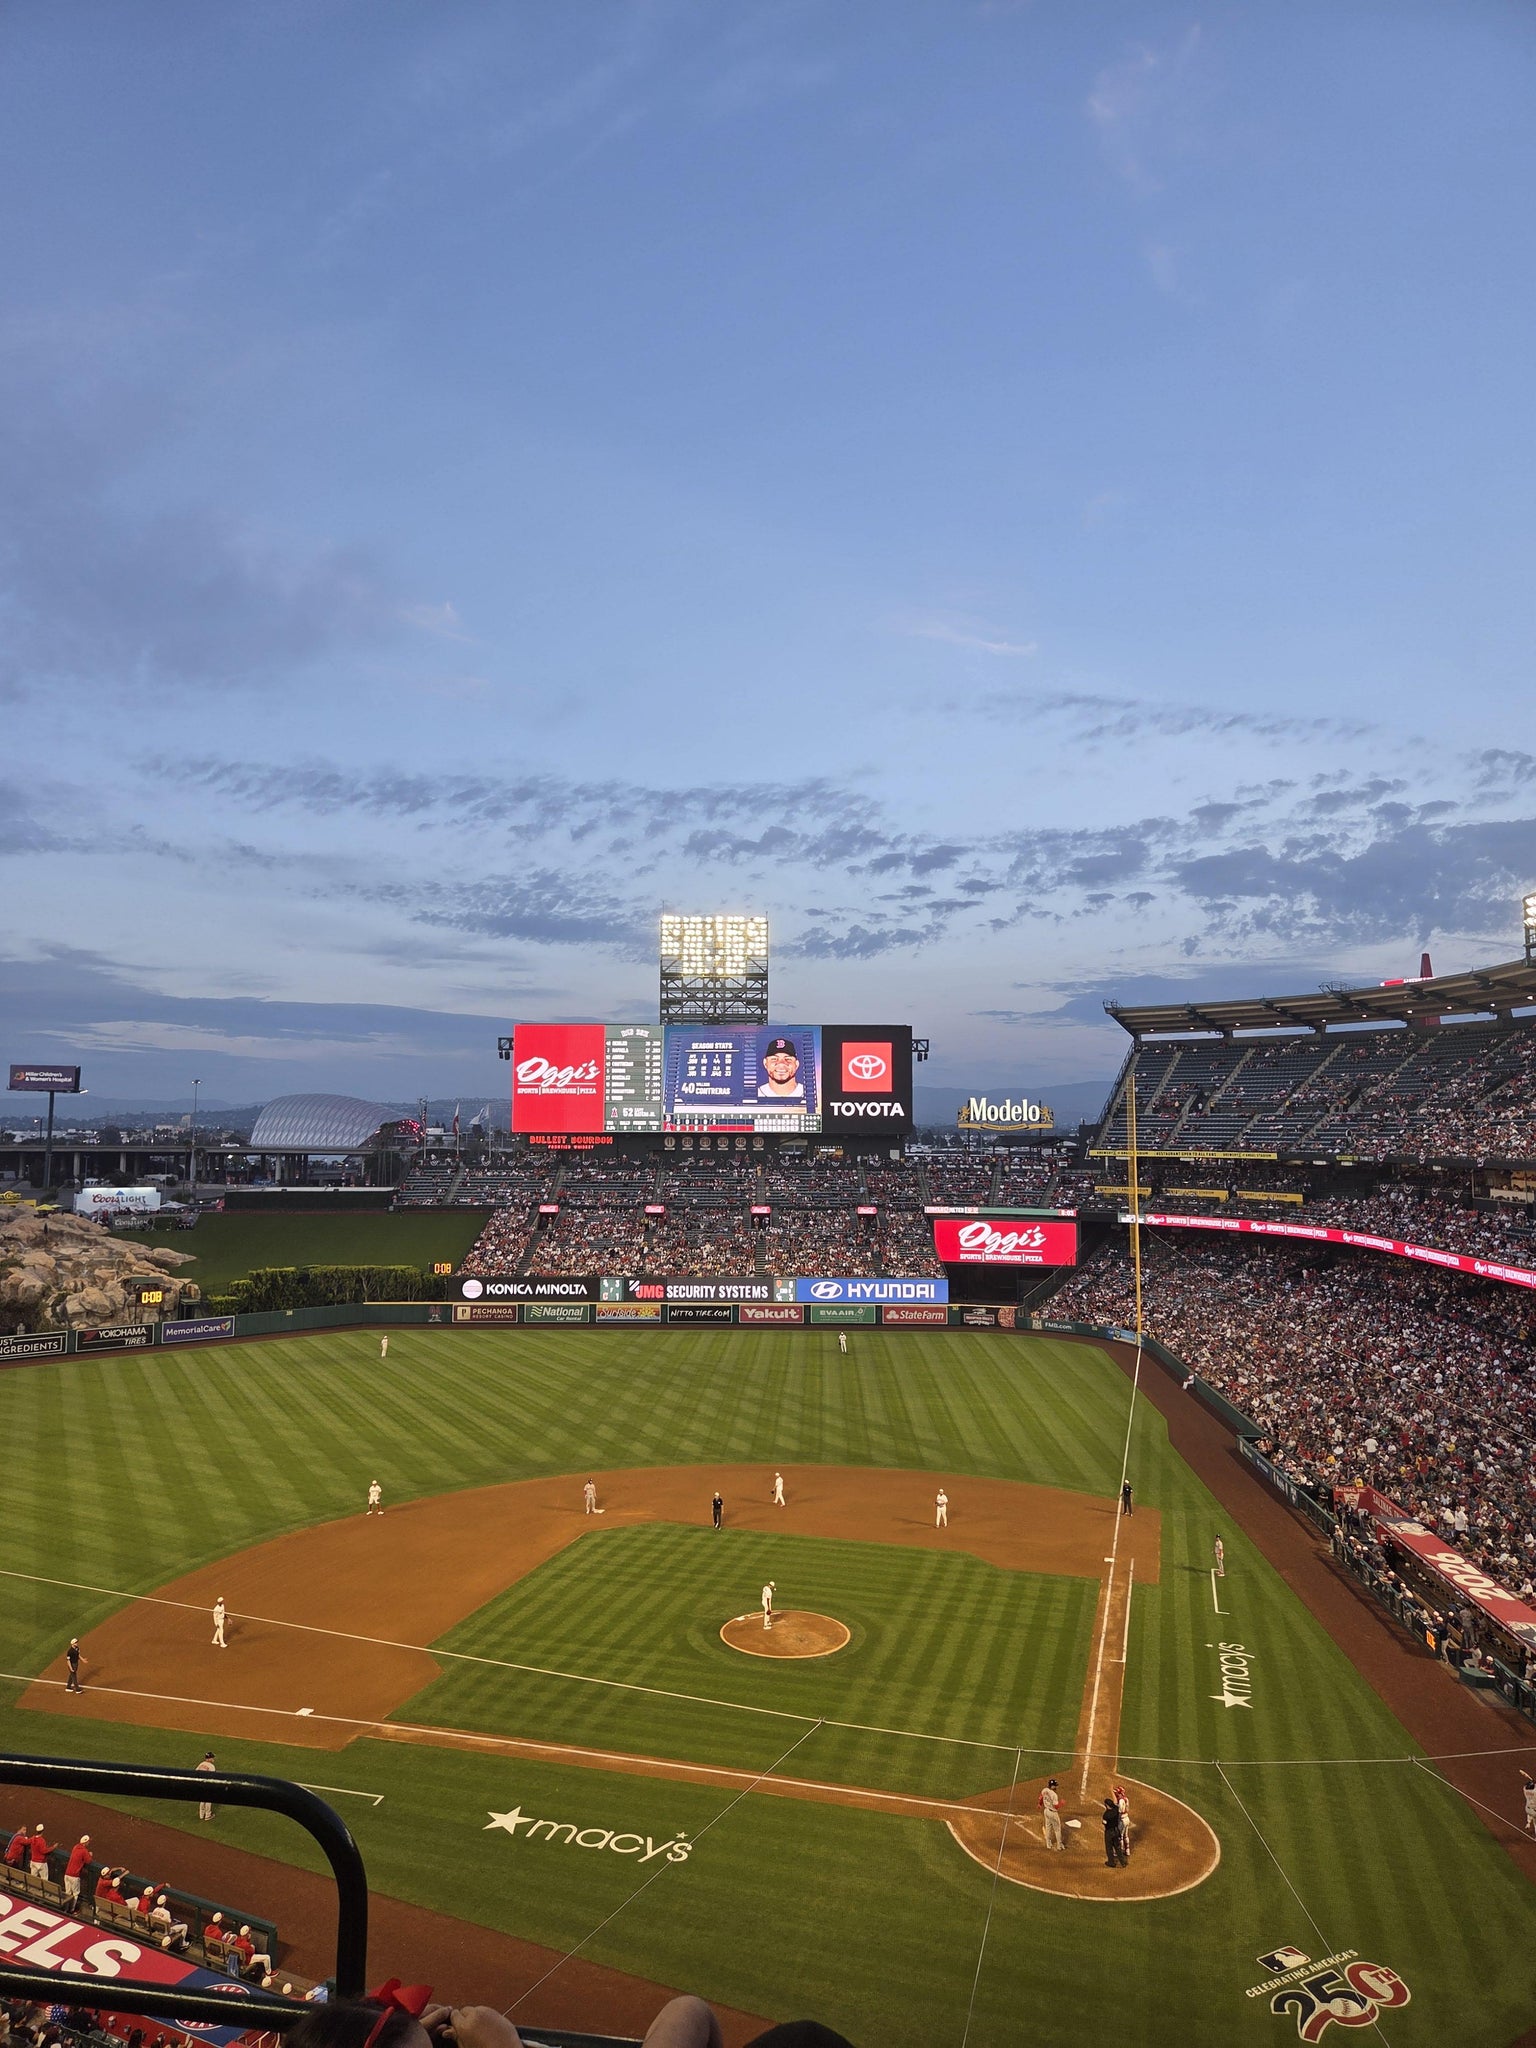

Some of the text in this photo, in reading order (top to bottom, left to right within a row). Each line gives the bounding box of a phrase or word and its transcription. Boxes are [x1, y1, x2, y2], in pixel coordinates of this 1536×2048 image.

[516, 1056, 600, 1088] Oggi's
[682, 1082, 696, 1094] 40
[830, 1102, 905, 1116] TOYOTA
[970, 1097, 1040, 1122] Modelo
[530, 1136, 613, 1144] BULLEIT BOURBON
[92, 1194, 120, 1202] Coors
[958, 1222, 1046, 1254] Oggi's
[434, 1263, 452, 1274] 0:08
[486, 1284, 588, 1295] KONICA MINOLTA
[636, 1285, 768, 1299] JMG SECURITY SYSTEMS
[848, 1284, 934, 1298] HYUNDAI
[142, 1291, 162, 1304] 0:08
[542, 1307, 583, 1317] National
[600, 1307, 636, 1320] Surfside
[671, 1309, 730, 1318] NITTO TIRE.COM
[744, 1308, 798, 1319] Yakult
[98, 1327, 147, 1338] YOKOHAMA
[166, 1324, 221, 1336] MemorialCare
[124, 1337, 146, 1346] TIRES
[1424, 1552, 1516, 1600] 2026
[1245, 1949, 1359, 1998] CELEBRATING AMERICA'S
[1270, 1962, 1411, 2044] 250 TH
